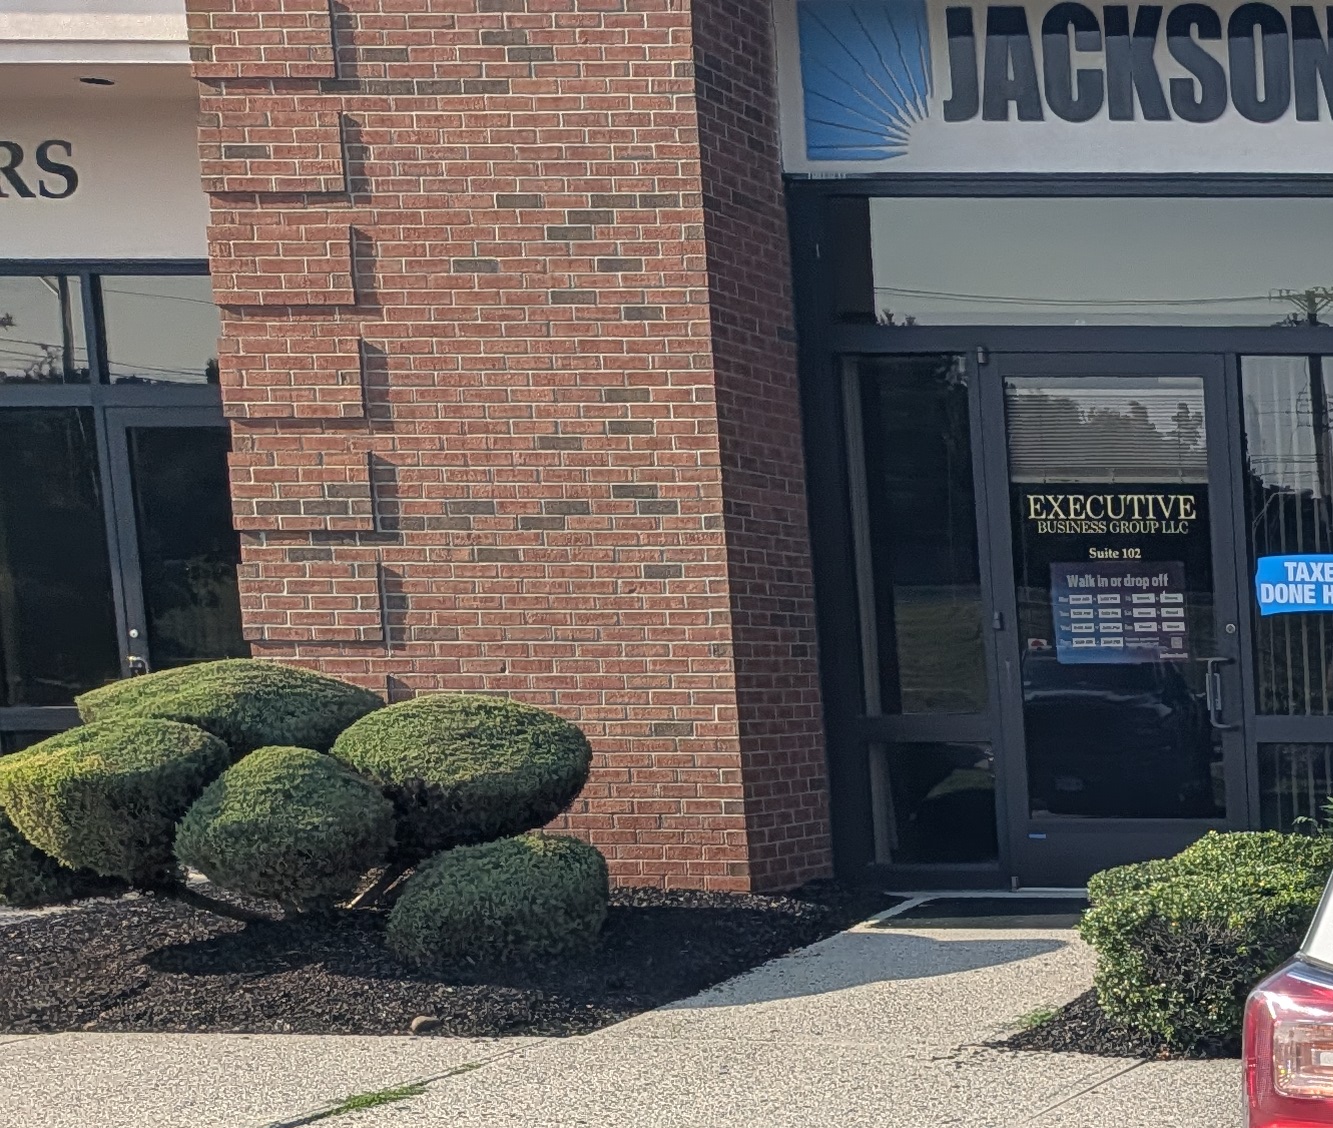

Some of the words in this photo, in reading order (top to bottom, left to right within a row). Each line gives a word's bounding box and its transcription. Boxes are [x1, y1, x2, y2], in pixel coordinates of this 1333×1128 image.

[1027, 494, 1197, 520] EXECUTIVE
[1037, 520, 1107, 534] BUSINESS
[1109, 520, 1159, 534] GROUP
[1161, 520, 1189, 534] LLC
[1089, 547, 1119, 559] Suite
[1122, 548, 1142, 559] 102
[1067, 574, 1096, 588] Walk
[1097, 574, 1109, 588] in
[1111, 578, 1122, 587] or
[1123, 574, 1150, 589] drop
[1151, 572, 1169, 587] off
[1261, 583, 1317, 604] DONE
